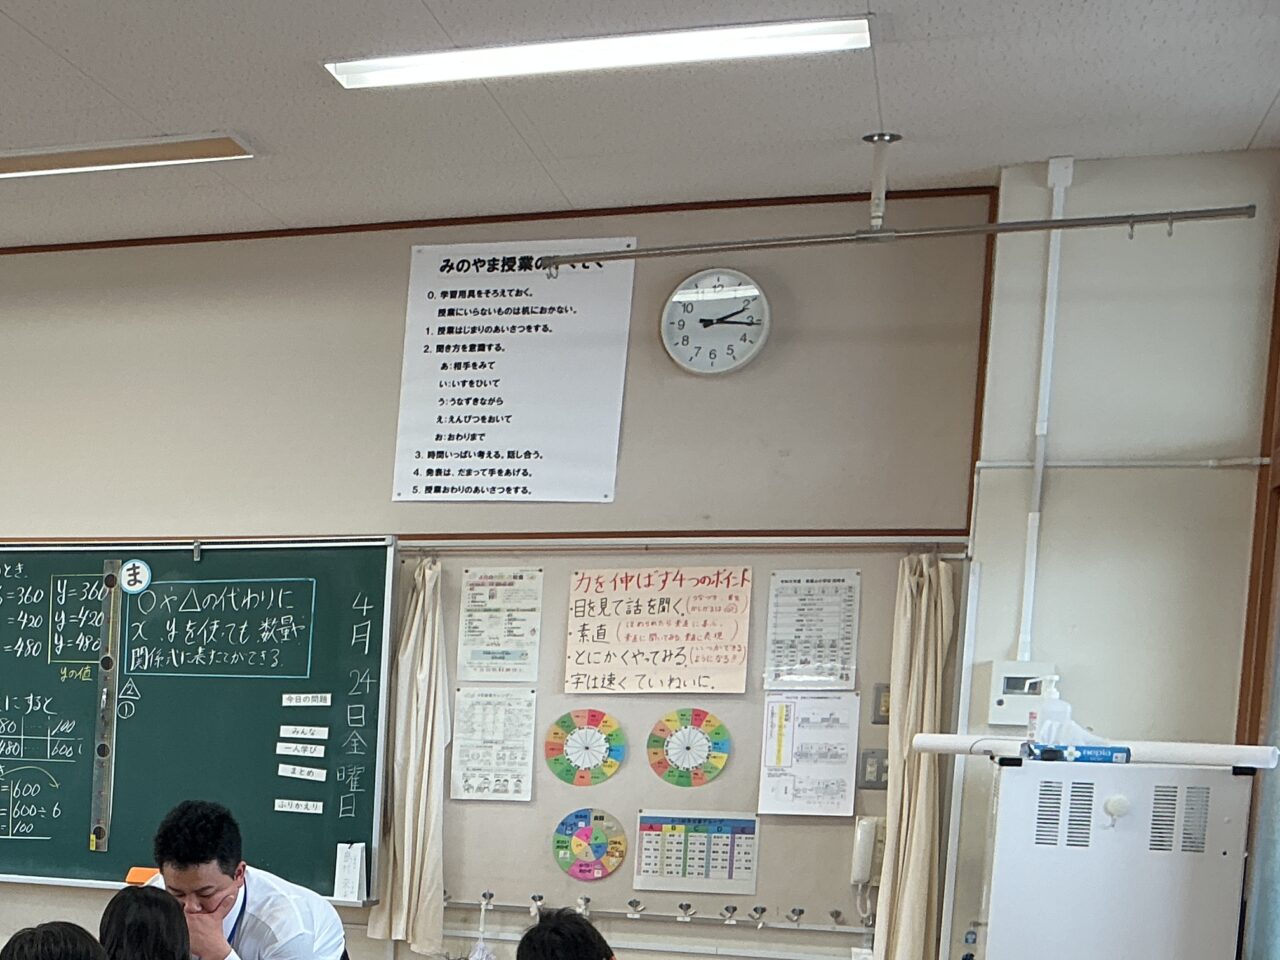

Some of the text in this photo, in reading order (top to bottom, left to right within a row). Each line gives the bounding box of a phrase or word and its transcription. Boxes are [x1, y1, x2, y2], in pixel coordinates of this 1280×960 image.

[439, 256, 604, 273] みのやま授業の
[440, 288, 533, 299] 学習用具をそろえておく。
[682, 303, 693, 313] 10
[437, 324, 552, 335] 授業はじまりのあいさつをする。
[678, 320, 685, 330] 9
[681, 335, 689, 346] 8
[740, 333, 747, 343] 4
[694, 347, 702, 357] 7
[709, 349, 717, 359] 6
[726, 345, 734, 355] 5
[125, 563, 143, 587] ま
[574, 568, 751, 594] 力を伸ばす4つのポイント
[577, 622, 611, 644] 素直
[51, 739, 74, 757] 600
[290, 767, 315, 778] まとめ
